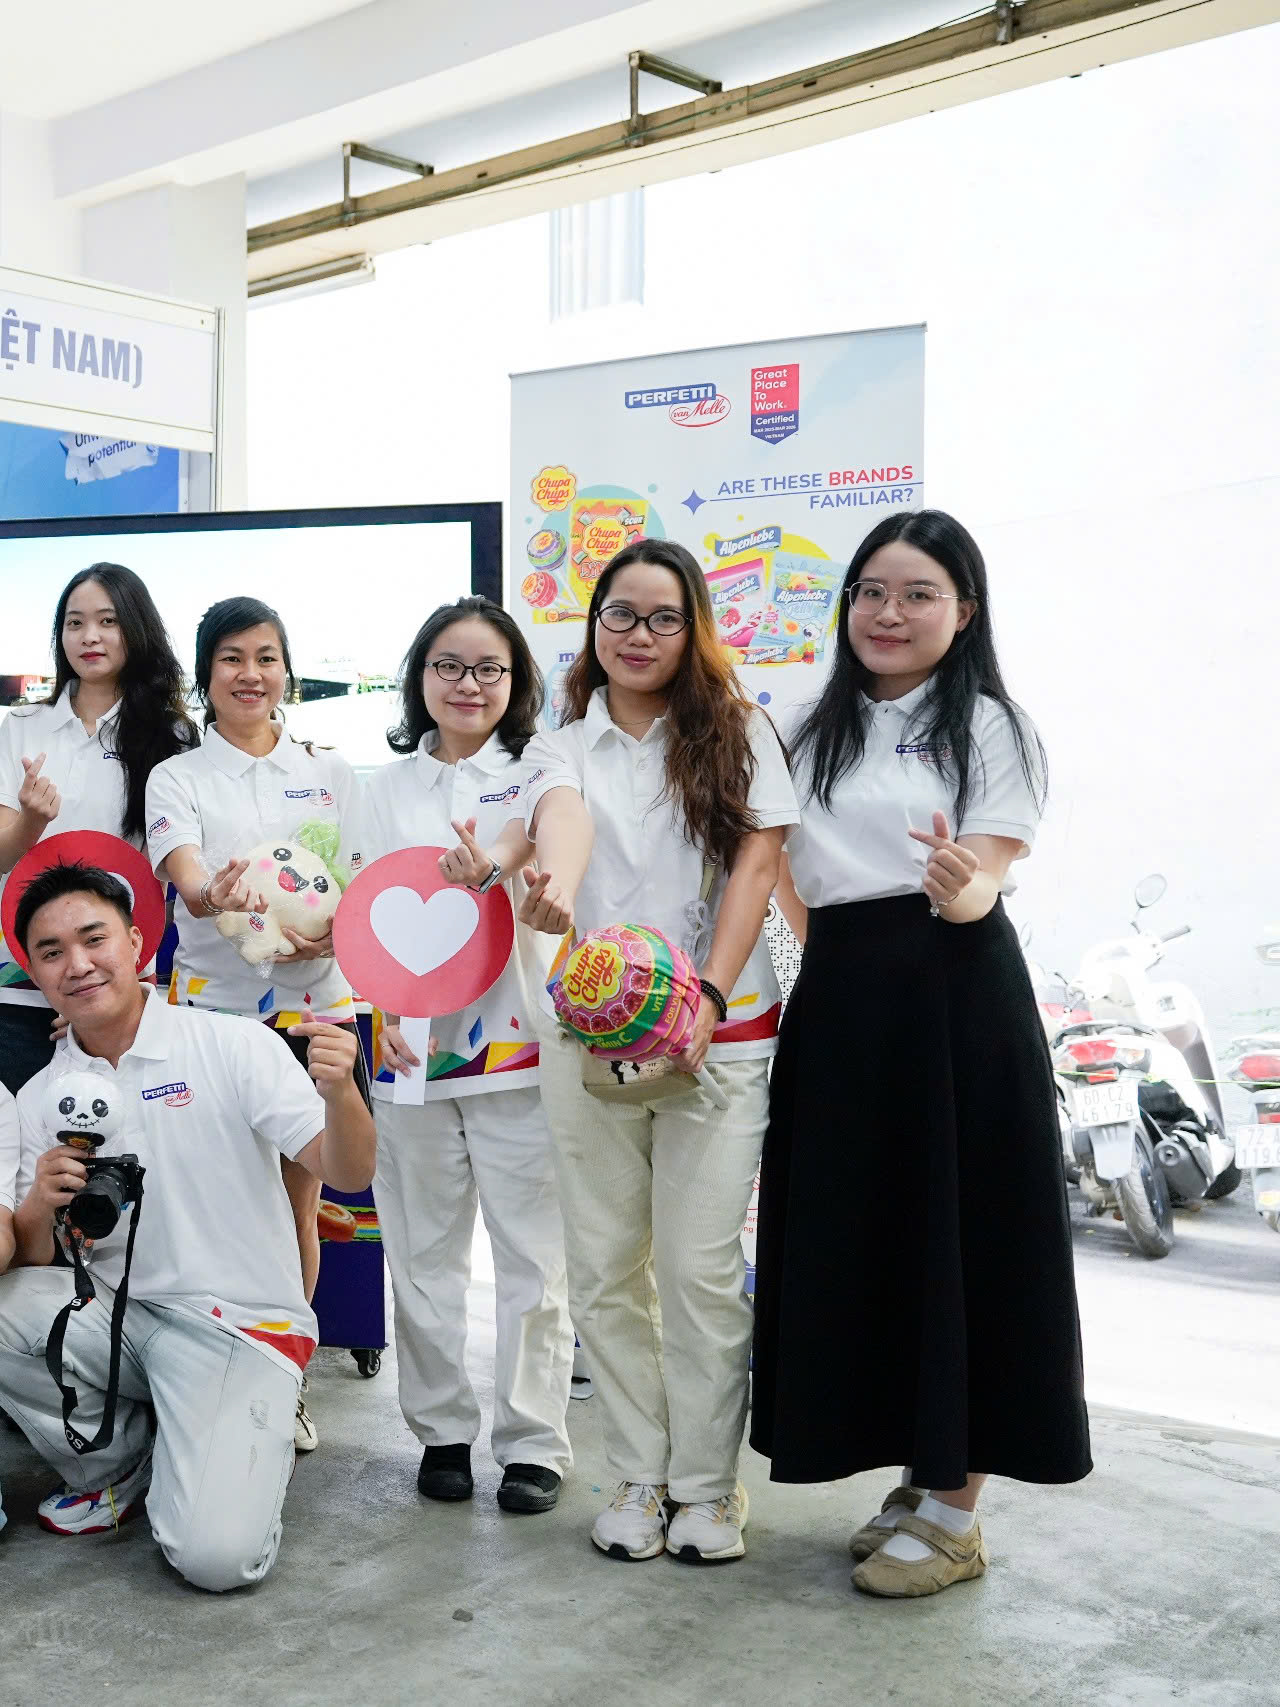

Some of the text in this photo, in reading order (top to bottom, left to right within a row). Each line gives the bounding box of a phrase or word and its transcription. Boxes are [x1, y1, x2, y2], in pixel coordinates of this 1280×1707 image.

[52, 329, 144, 389] NAM)
[753, 368, 788, 381] Great
[754, 379, 787, 391] Place
[627, 386, 713, 406] PERFETTI
[754, 391, 767, 401] To
[693, 399, 725, 416] Melle
[755, 413, 795, 426] Certified
[538, 477, 571, 490] Chupa
[717, 465, 914, 496] ARE THESE BRANDS
[536, 488, 570, 504] Chups
[809, 487, 914, 510] FAMILIAR?
[588, 526, 623, 540] Chupa
[585, 537, 620, 555] Chups
[719, 528, 776, 557] Alpenliebe
[567, 944, 596, 996] Chupa
[581, 948, 614, 1004] Chups
[144, 1083, 185, 1099] PERFETTI
